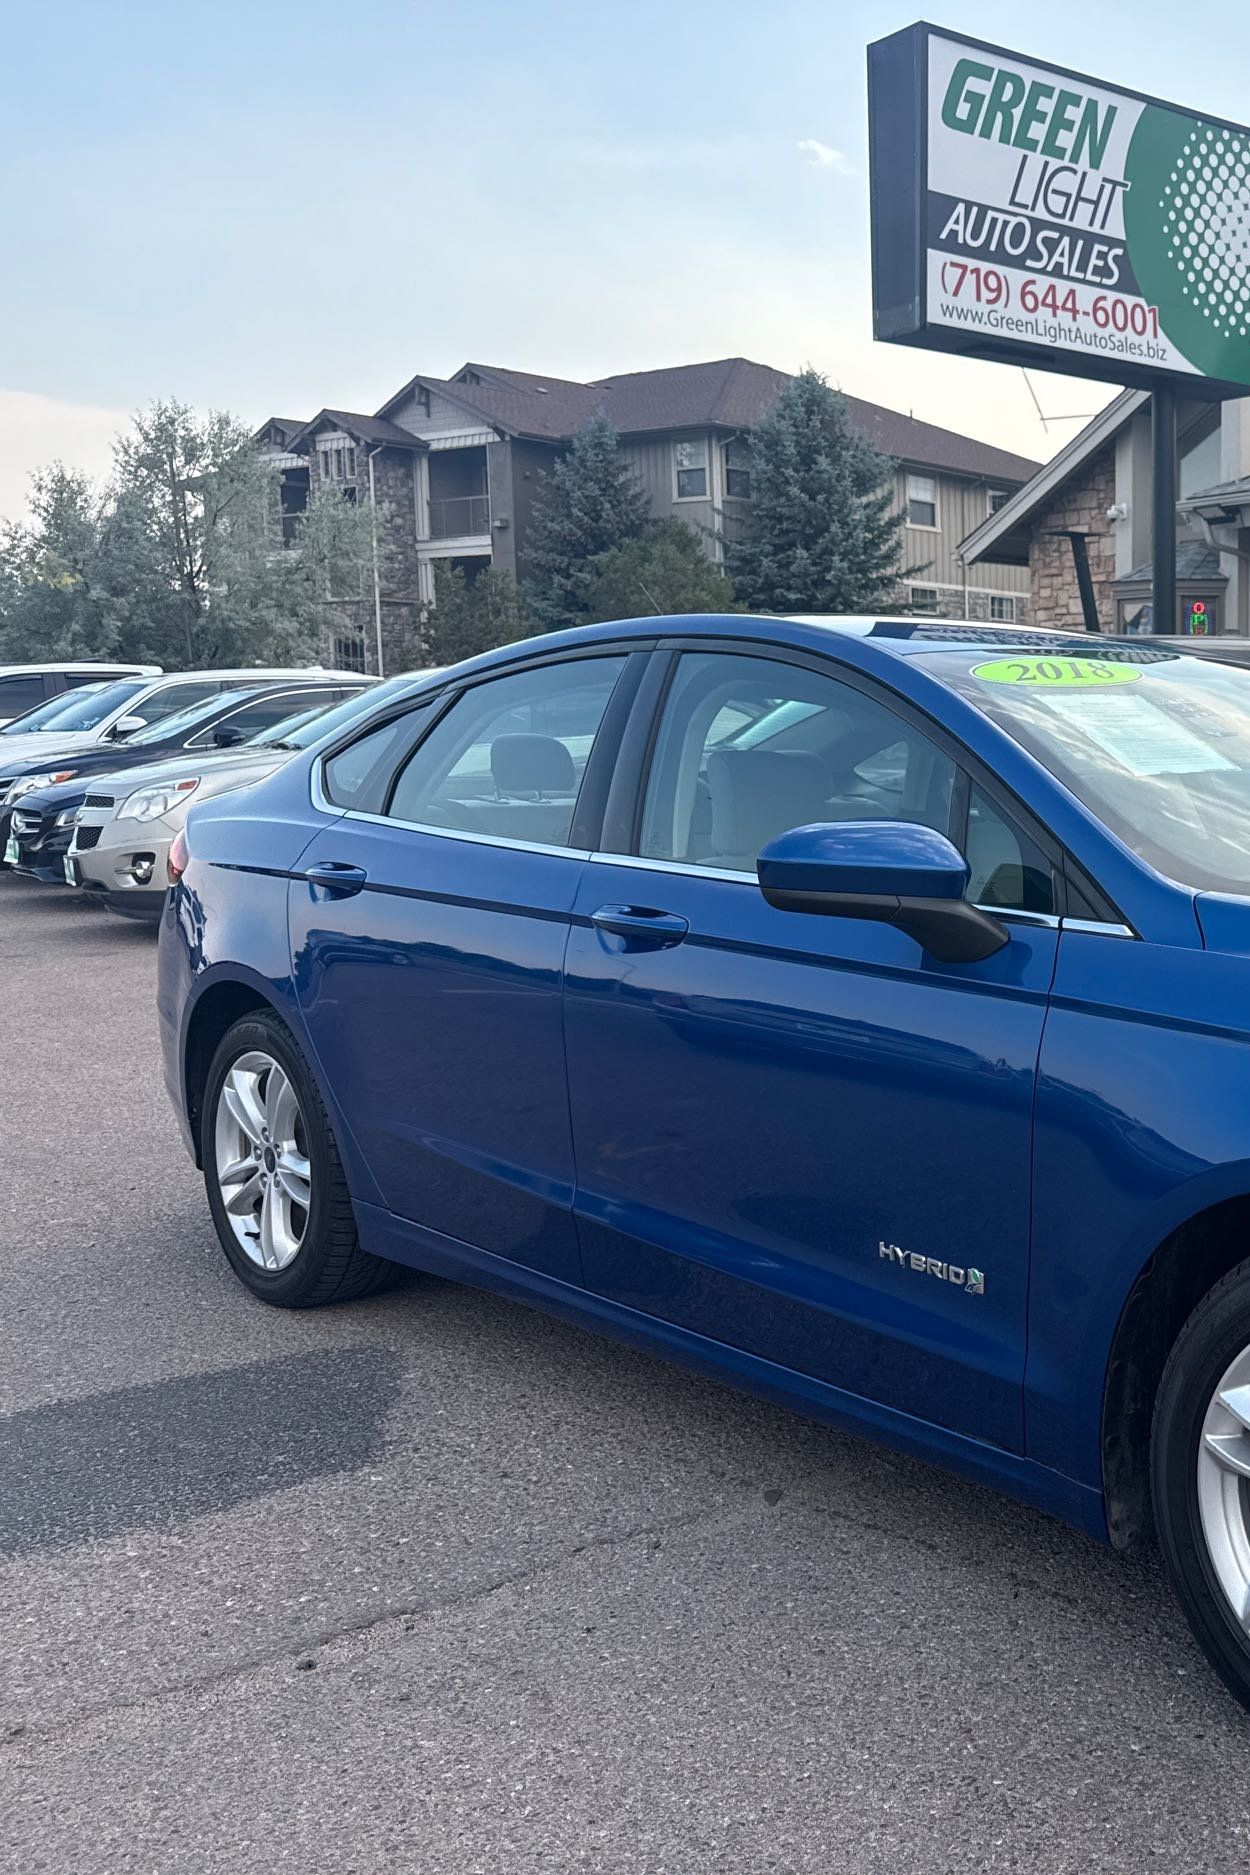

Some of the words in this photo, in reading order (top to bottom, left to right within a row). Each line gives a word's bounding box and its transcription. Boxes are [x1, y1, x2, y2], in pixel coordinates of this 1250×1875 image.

[942, 58, 1117, 170] GREEN
[1008, 153, 1131, 231] LIGHT
[939, 202, 1031, 256] AUTO
[1025, 230, 1124, 286] SALES
[940, 261, 1010, 309] (719)
[1019, 279, 1160, 339] 644-6001
[940, 303, 1168, 362] www.GreenLightAutoSales.biz
[1007, 661, 1115, 682] 2018
[879, 1241, 965, 1285] HYBRID
